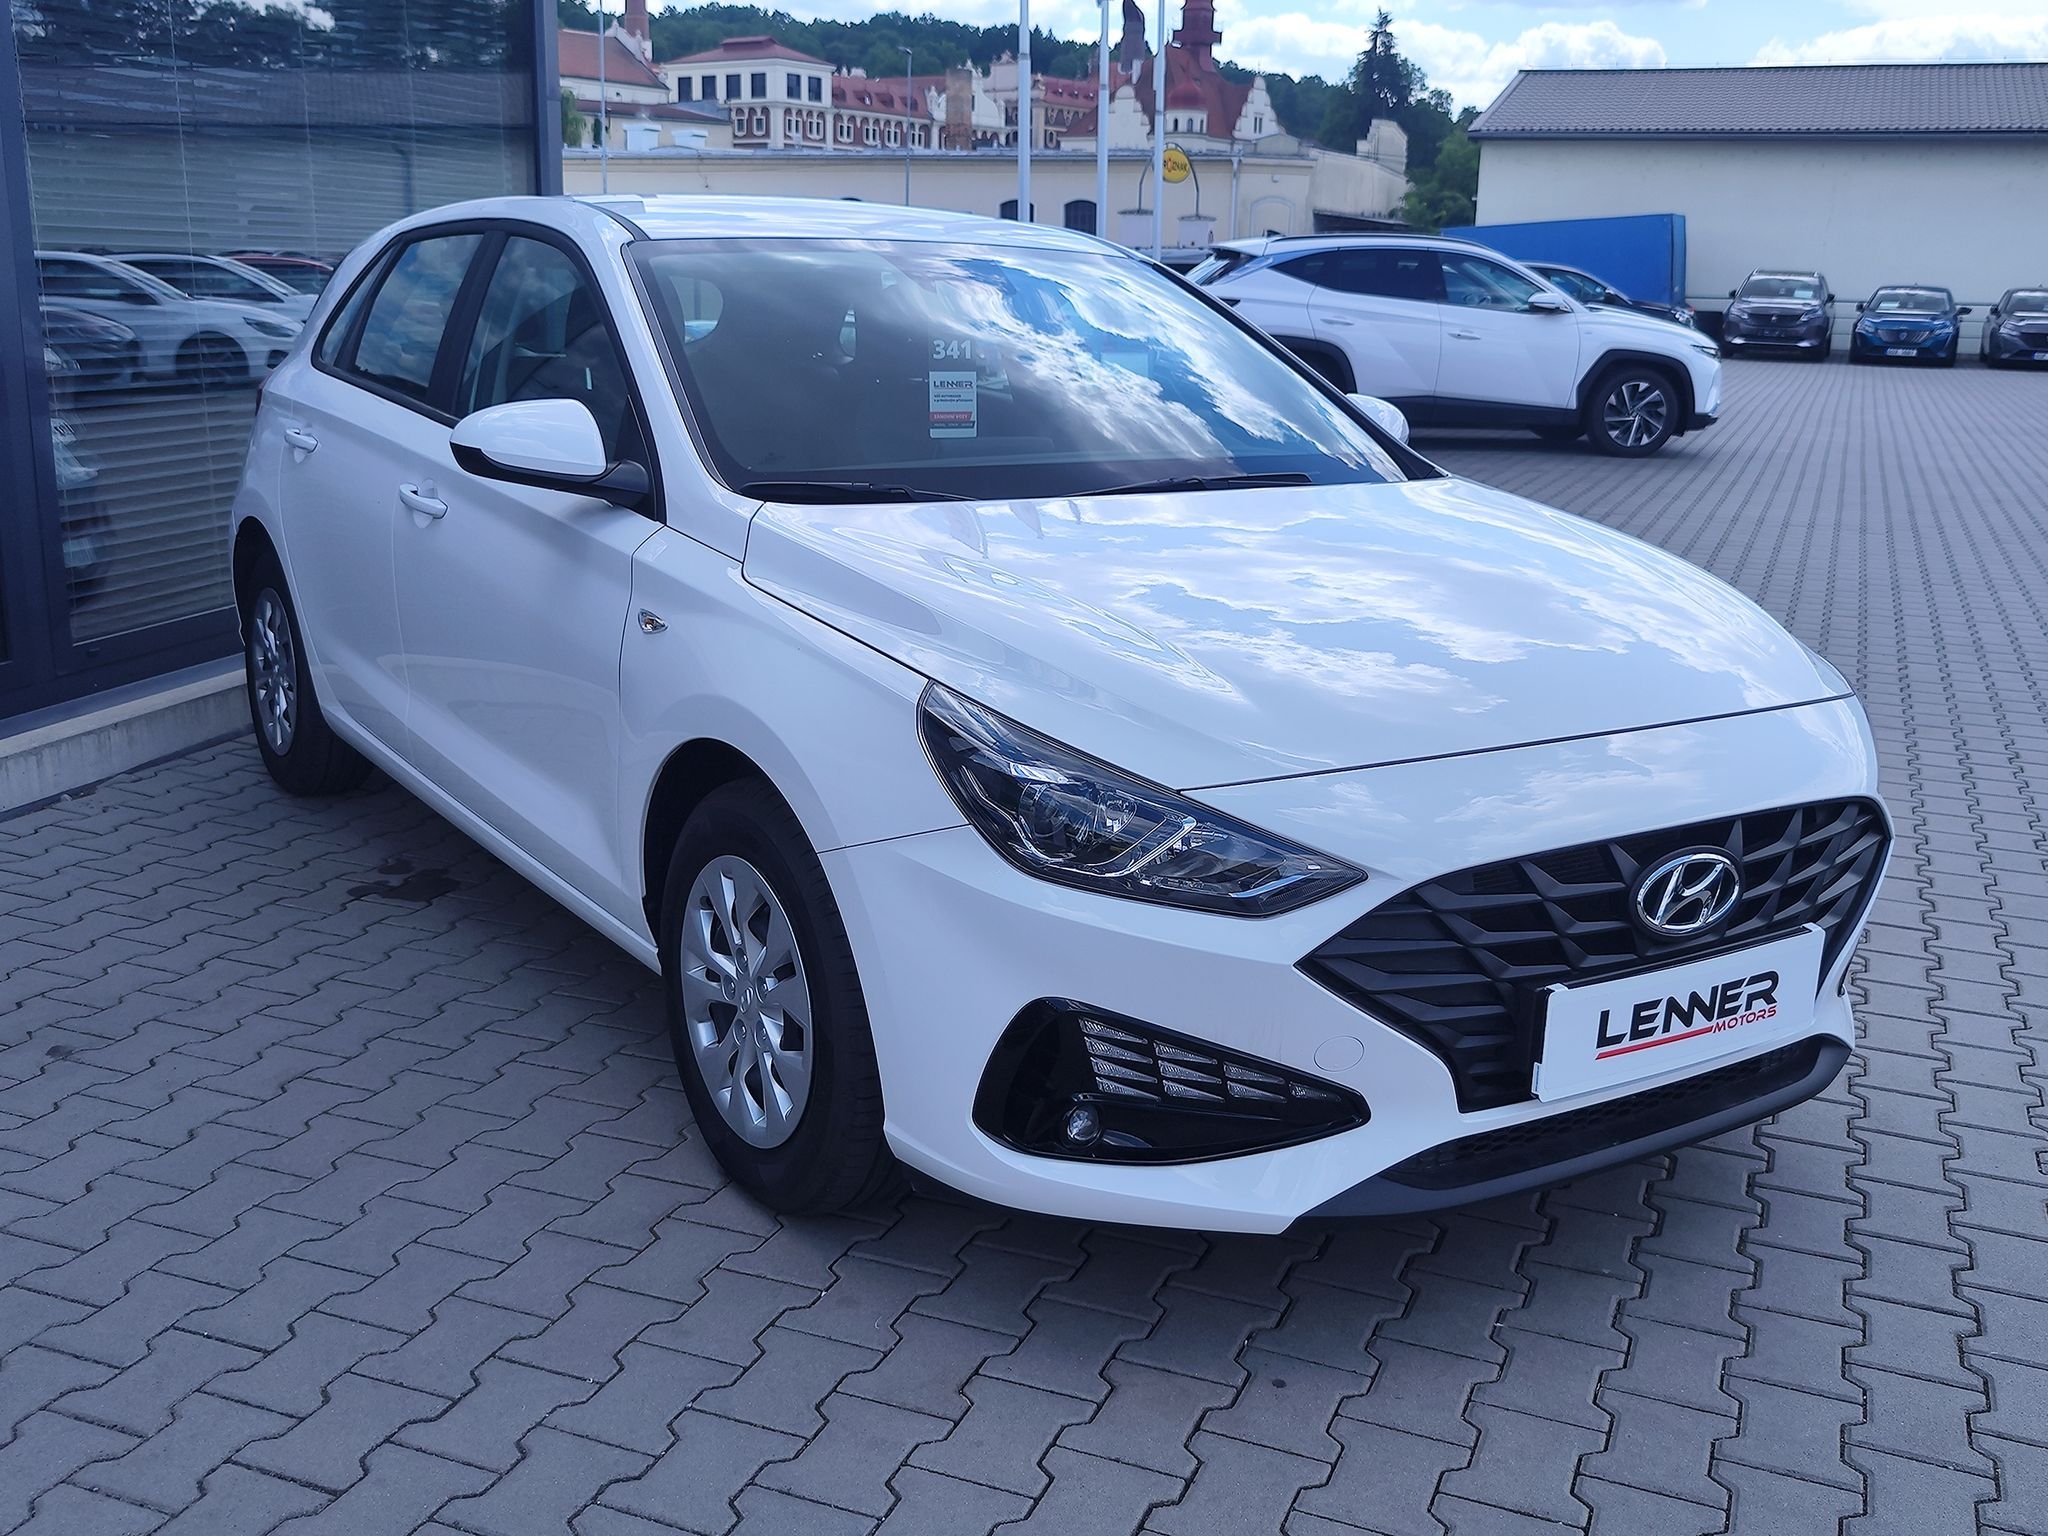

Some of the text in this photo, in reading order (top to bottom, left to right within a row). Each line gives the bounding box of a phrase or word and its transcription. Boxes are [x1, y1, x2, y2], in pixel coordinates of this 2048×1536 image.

[933, 339, 971, 360] 341
[933, 380, 974, 389] LENNER
[1596, 970, 1780, 1049] LENNER
[1712, 1004, 1778, 1034] MOTORS
